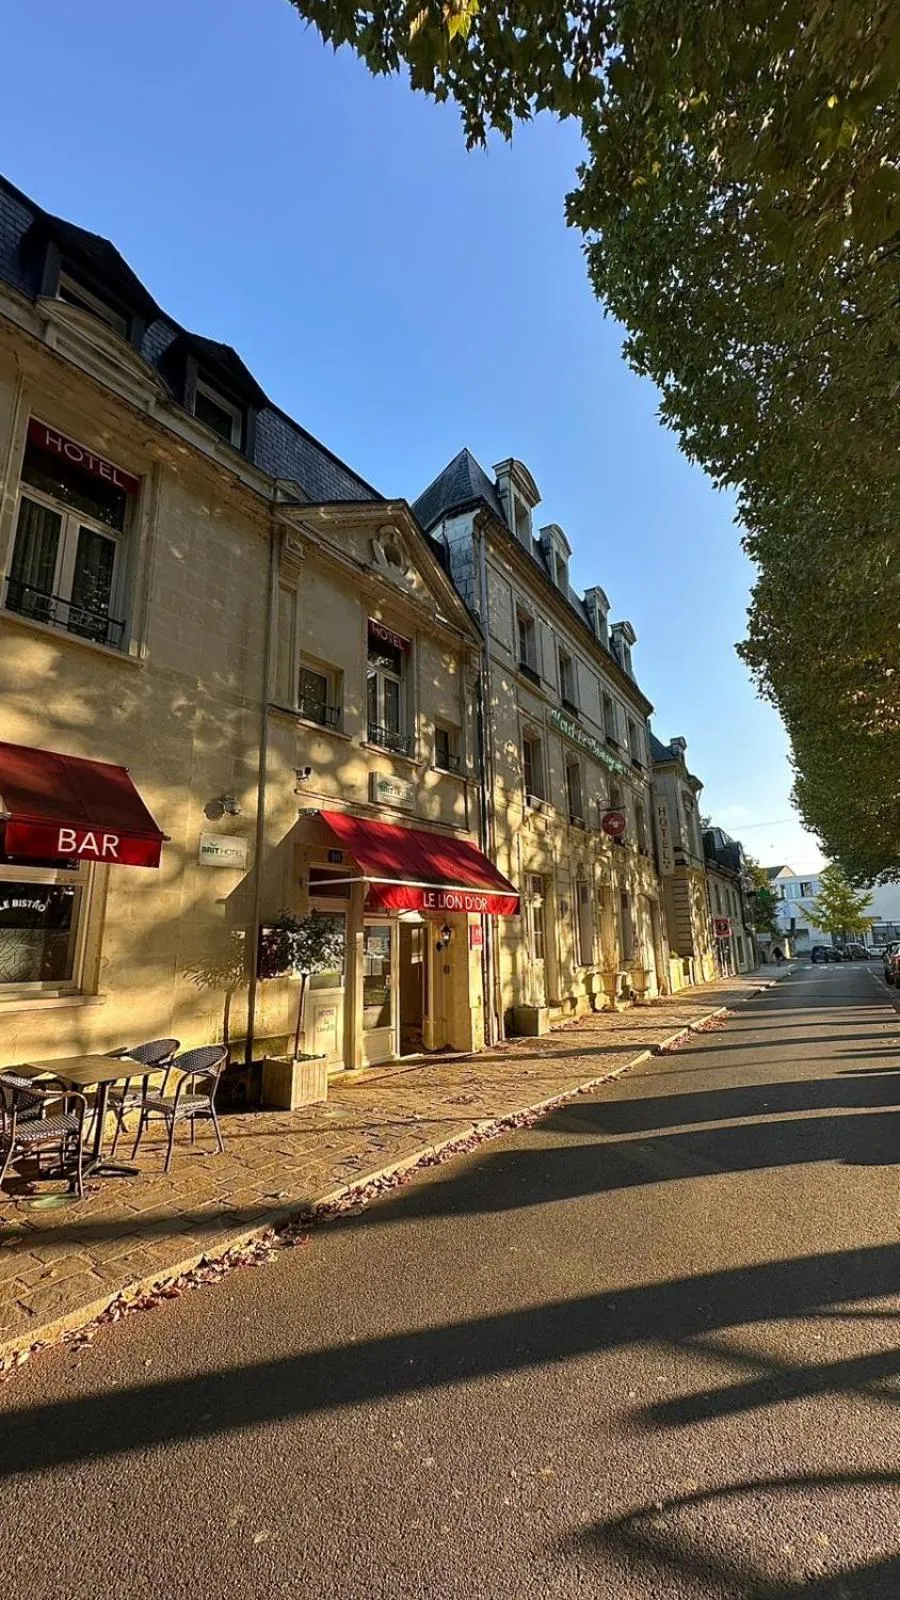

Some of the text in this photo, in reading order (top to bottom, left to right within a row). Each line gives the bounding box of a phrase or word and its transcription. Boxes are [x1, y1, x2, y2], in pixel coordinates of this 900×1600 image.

[45, 430, 124, 488] HOTEL
[371, 622, 405, 650] HOTEL
[57, 828, 120, 858] BAR
[657, 806, 670, 860] HOTEL
[12, 898, 46, 912] BISTRO
[423, 892, 488, 911] LE LION D'OR
